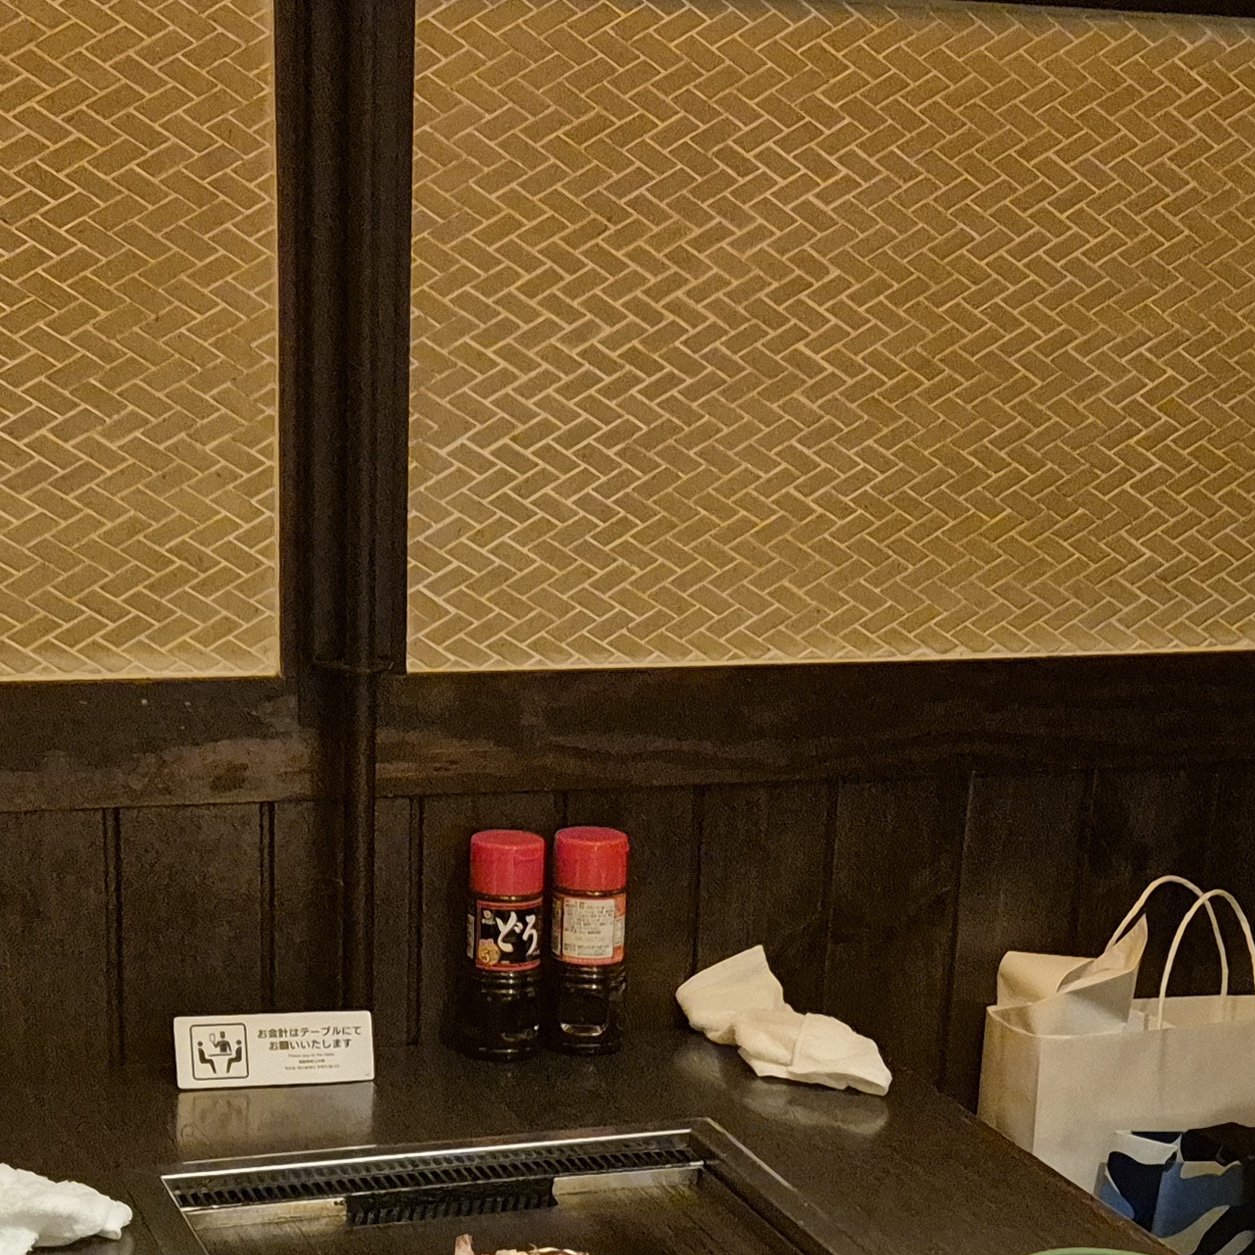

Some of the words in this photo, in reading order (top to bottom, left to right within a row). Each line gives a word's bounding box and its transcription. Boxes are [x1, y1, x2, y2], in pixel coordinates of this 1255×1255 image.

[257, 1026, 362, 1039] お会計はテーブルにて
